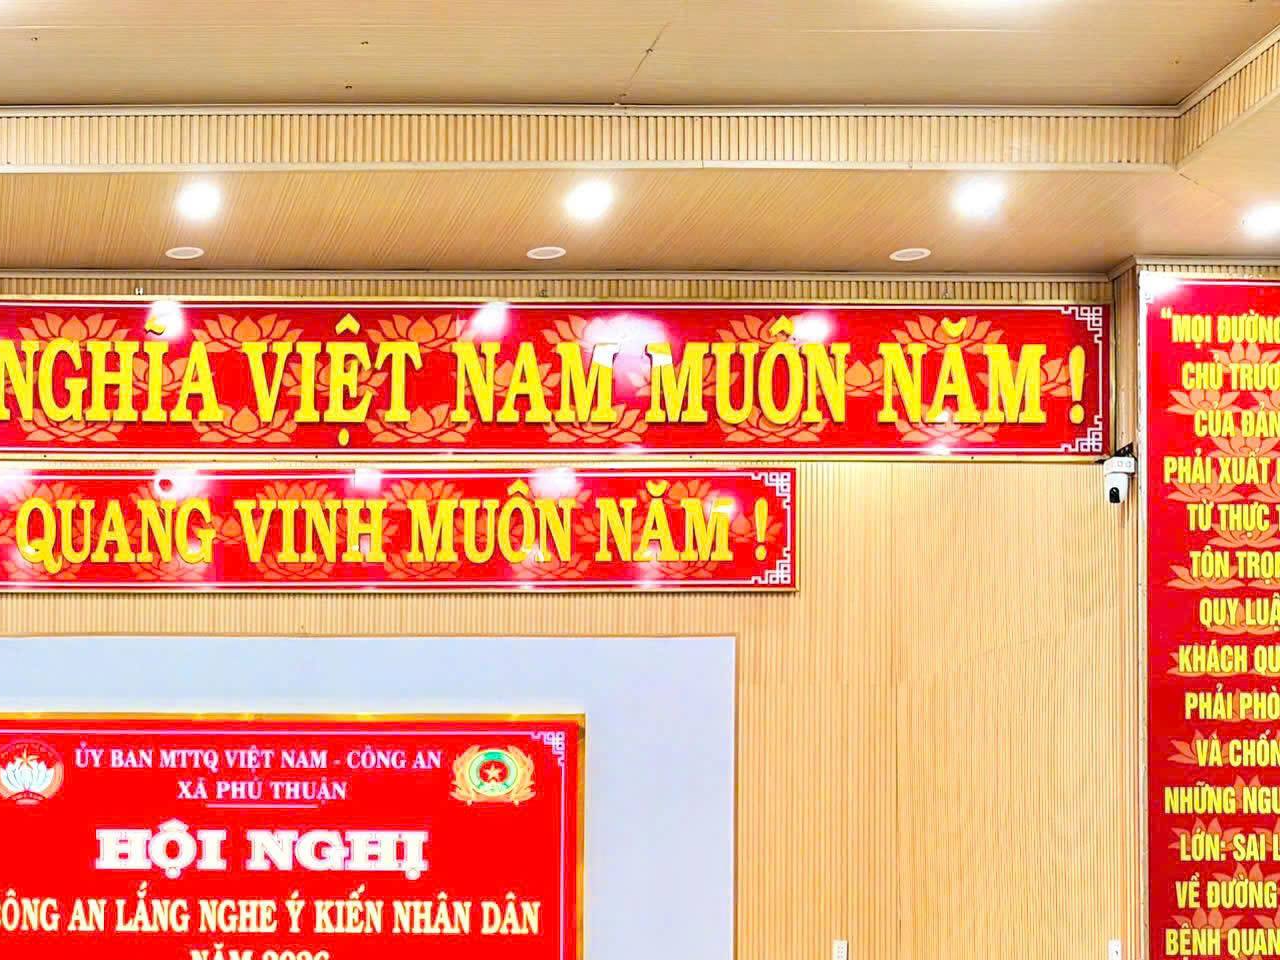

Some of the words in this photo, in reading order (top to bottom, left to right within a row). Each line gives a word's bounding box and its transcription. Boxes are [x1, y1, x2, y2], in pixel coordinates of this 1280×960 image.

[241, 312, 422, 446] VIỆT
[451, 342, 620, 423] NAM
[645, 315, 850, 424] MUÔN
[878, 317, 1047, 423] NĂM
[1182, 352, 1223, 390] CHỦ
[1229, 361, 1280, 391] TRƯƠ
[1194, 400, 1235, 437] CỦA
[1241, 400, 1280, 437] ĐẢN
[1163, 447, 1212, 484] PHẢI
[1218, 448, 1271, 484] XUẤT
[15, 498, 216, 575] QUANG
[234, 498, 386, 563] VINH
[406, 478, 576, 563] MUÔN
[595, 481, 733, 562] NĂM
[1186, 498, 1214, 531] TỪ
[1218, 501, 1270, 538] THỰC
[1189, 545, 1230, 579] TÔN
[1235, 551, 1280, 584] TRỌ
[1199, 597, 1239, 629] QUY
[1245, 592, 1280, 631] LUẬ
[1178, 639, 1248, 673] KHÁCH
[1254, 645, 1280, 676] QU
[1185, 682, 1233, 720] PHẢI
[1239, 685, 1280, 720] PHÒ
[74, 741, 108, 768] ỦY
[110, 749, 153, 768] BAN
[159, 749, 219, 774] MTTQ
[224, 745, 274, 774] VIỆT
[281, 750, 328, 769] NAM
[347, 746, 407, 769] CÔNG
[412, 751, 441, 769] AN
[1196, 736, 1223, 767] VÀ
[1229, 729, 1280, 767] CHỐN
[177, 776, 208, 799] XÃ
[216, 775, 263, 800] PHÚ
[272, 776, 347, 805] THUẬN
[1164, 781, 1236, 814] NHỮNG
[1242, 786, 1280, 814] NGU
[95, 818, 227, 879] HỘI
[246, 829, 429, 880] NGHỊ
[1180, 828, 1226, 861] LỚN:
[1233, 833, 1266, 862] SAI
[67, 899, 108, 931] AN
[115, 880, 190, 932] LẮNG
[199, 899, 277, 933] NGHE
[285, 890, 305, 933] Ý
[314, 884, 384, 934] KIẾN
[392, 892, 472, 934] NHÂN
[481, 892, 540, 934] DÂN
[1175, 872, 1201, 909] VỀ
[1206, 874, 1278, 909] ĐƯỜNG
